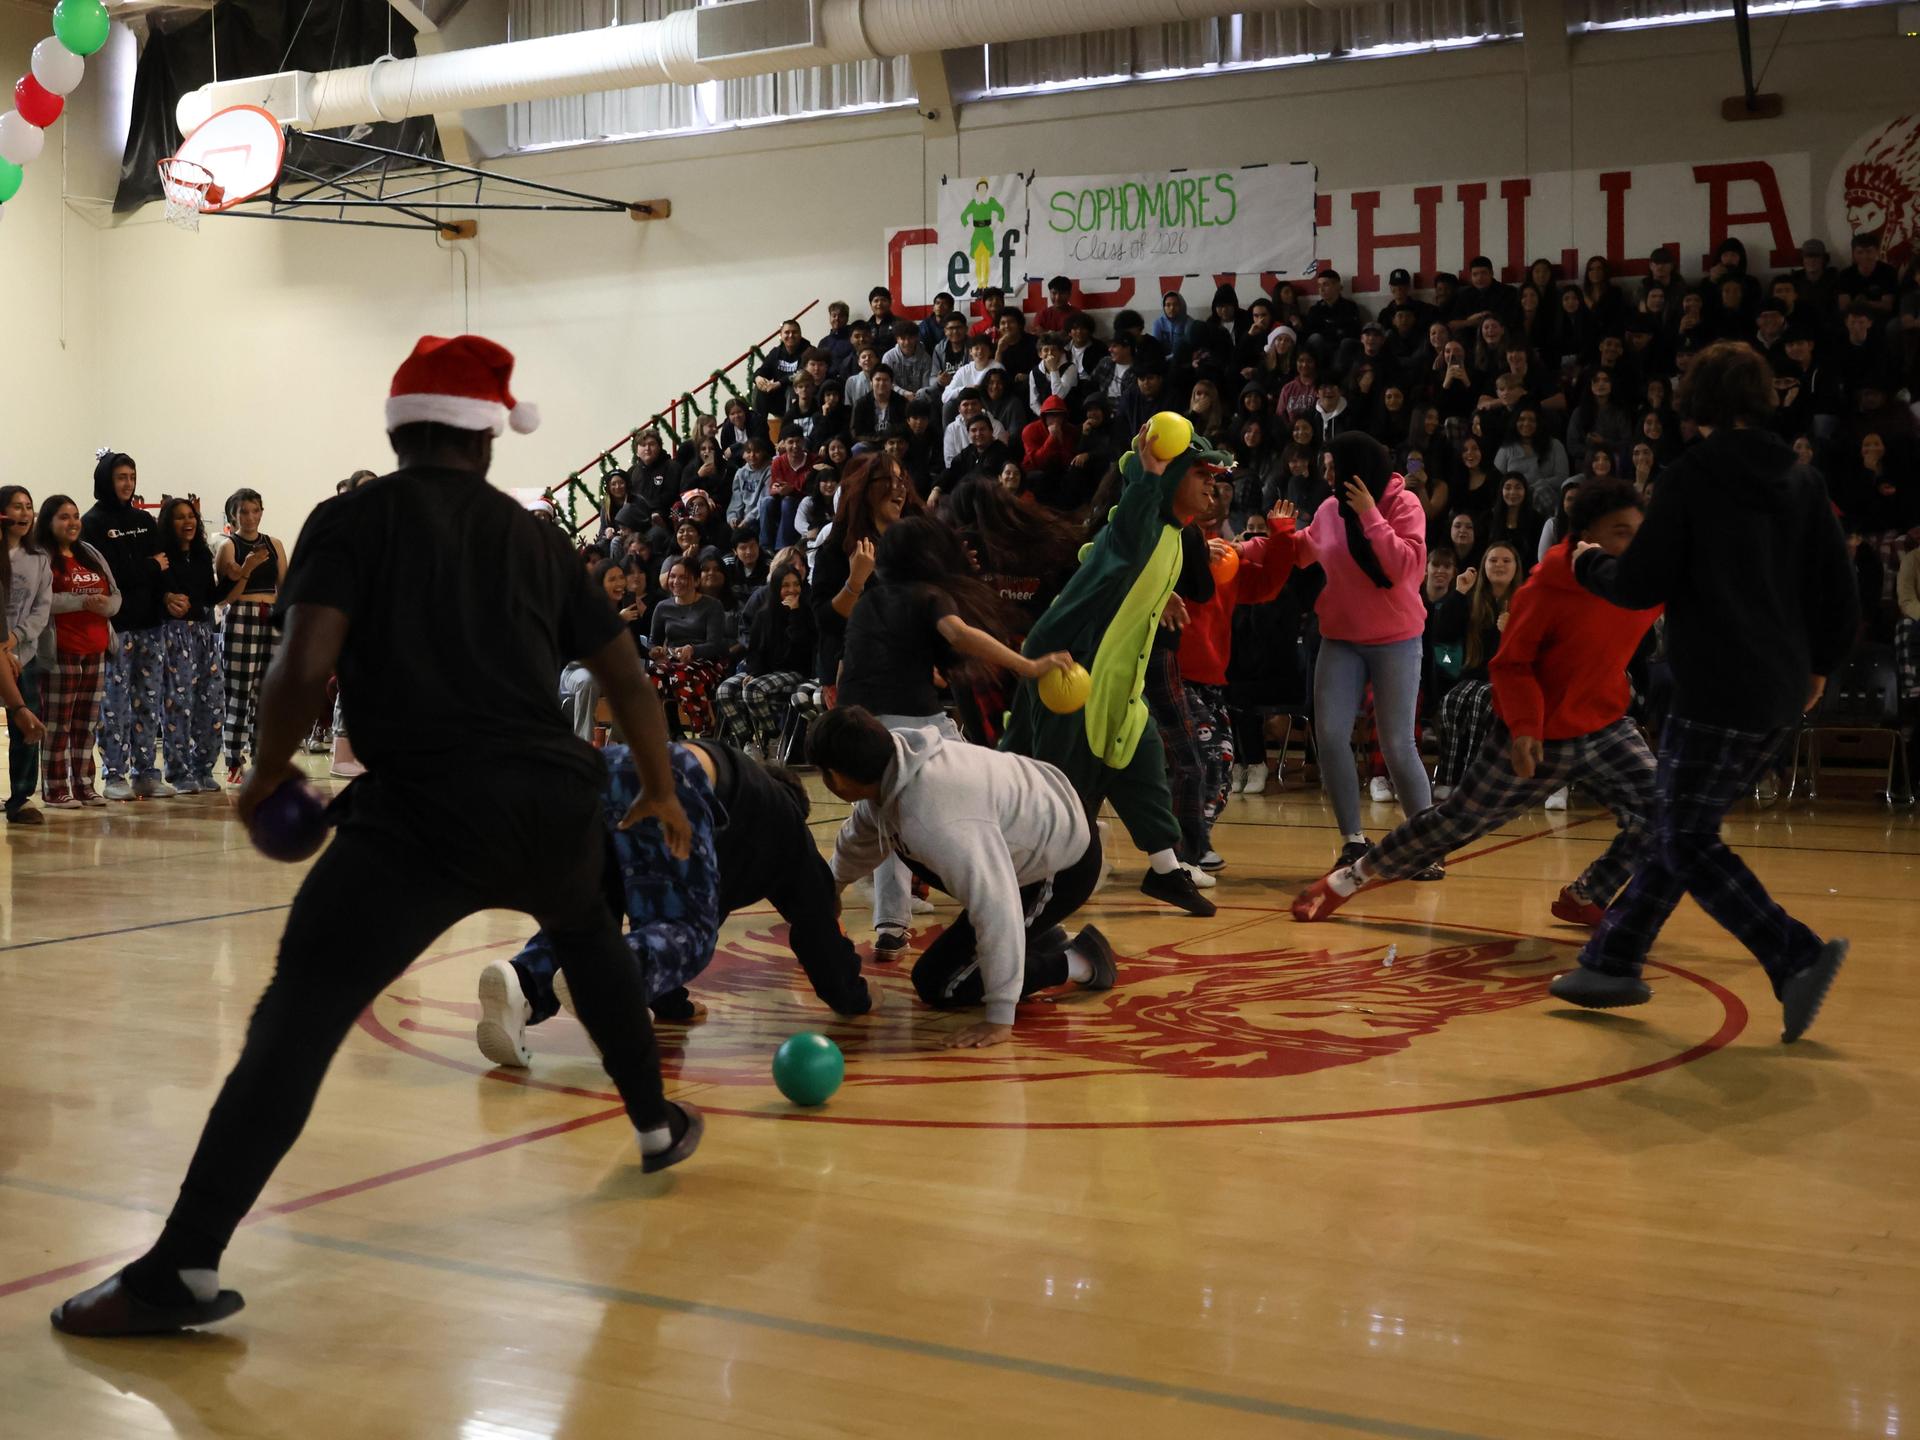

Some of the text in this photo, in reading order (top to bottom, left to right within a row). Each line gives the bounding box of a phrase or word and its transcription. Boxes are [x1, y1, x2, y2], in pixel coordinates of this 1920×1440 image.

[1048, 173, 1237, 233] SOPHOMORES
[1069, 231, 1188, 261] Class of 2026
[73, 572, 101, 583] ASB
[1000, 588, 1035, 601] Cheer
